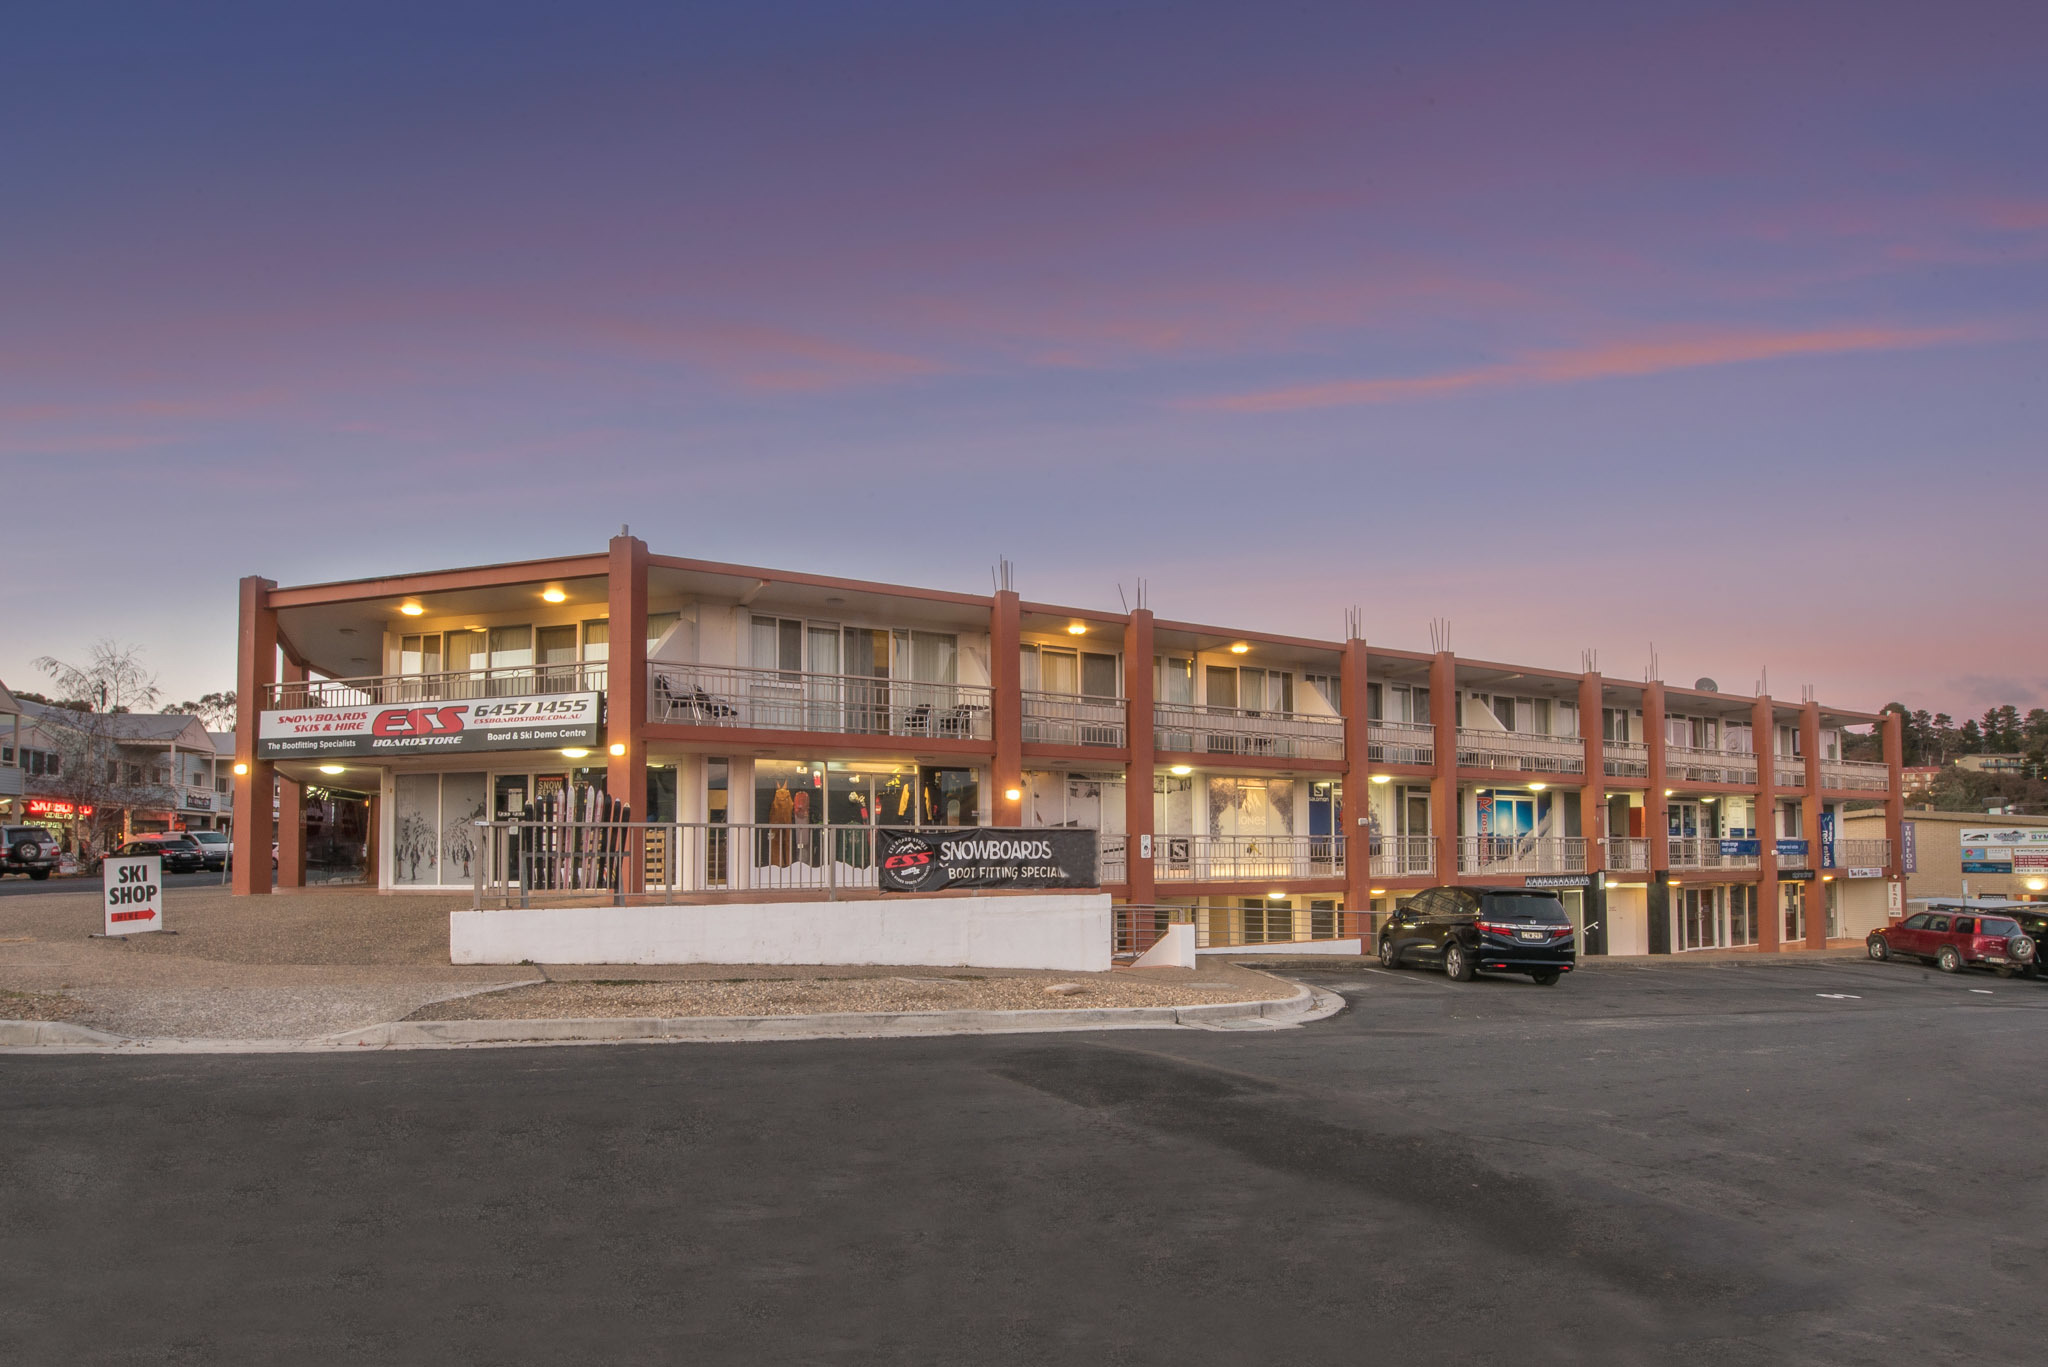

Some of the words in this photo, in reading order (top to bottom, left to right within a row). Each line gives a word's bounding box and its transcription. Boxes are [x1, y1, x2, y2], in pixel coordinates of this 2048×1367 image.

[474, 702, 532, 717] 6457
[535, 699, 589, 714] 1455
[277, 711, 369, 724] SNOWBOARDS
[372, 705, 470, 737] ESS
[473, 713, 582, 725] ESSBOARDSTORE.COM.AU
[293, 723, 320, 733] SKIS
[322, 723, 332, 731] &
[334, 721, 366, 731] HIRE
[487, 731, 511, 741] Board
[512, 731, 518, 739] &
[520, 730, 532, 739] Ski
[534, 729, 557, 739] Demo
[559, 729, 587, 738] Centre
[268, 742, 280, 750] The
[282, 739, 318, 750] Bootfitting
[319, 739, 356, 749] Specialists
[372, 736, 463, 747] BOARDSTORE
[538, 781, 563, 790] SNOW
[1904, 825, 1912, 847] THAI
[940, 840, 1053, 860] SNOWBOARDS
[884, 851, 933, 869] ESS
[1905, 848, 1913, 869] FOOD
[118, 864, 148, 884] SKI
[948, 866, 976, 879] BOOT
[978, 866, 1018, 880] FITTING
[109, 884, 158, 905] SHOP
